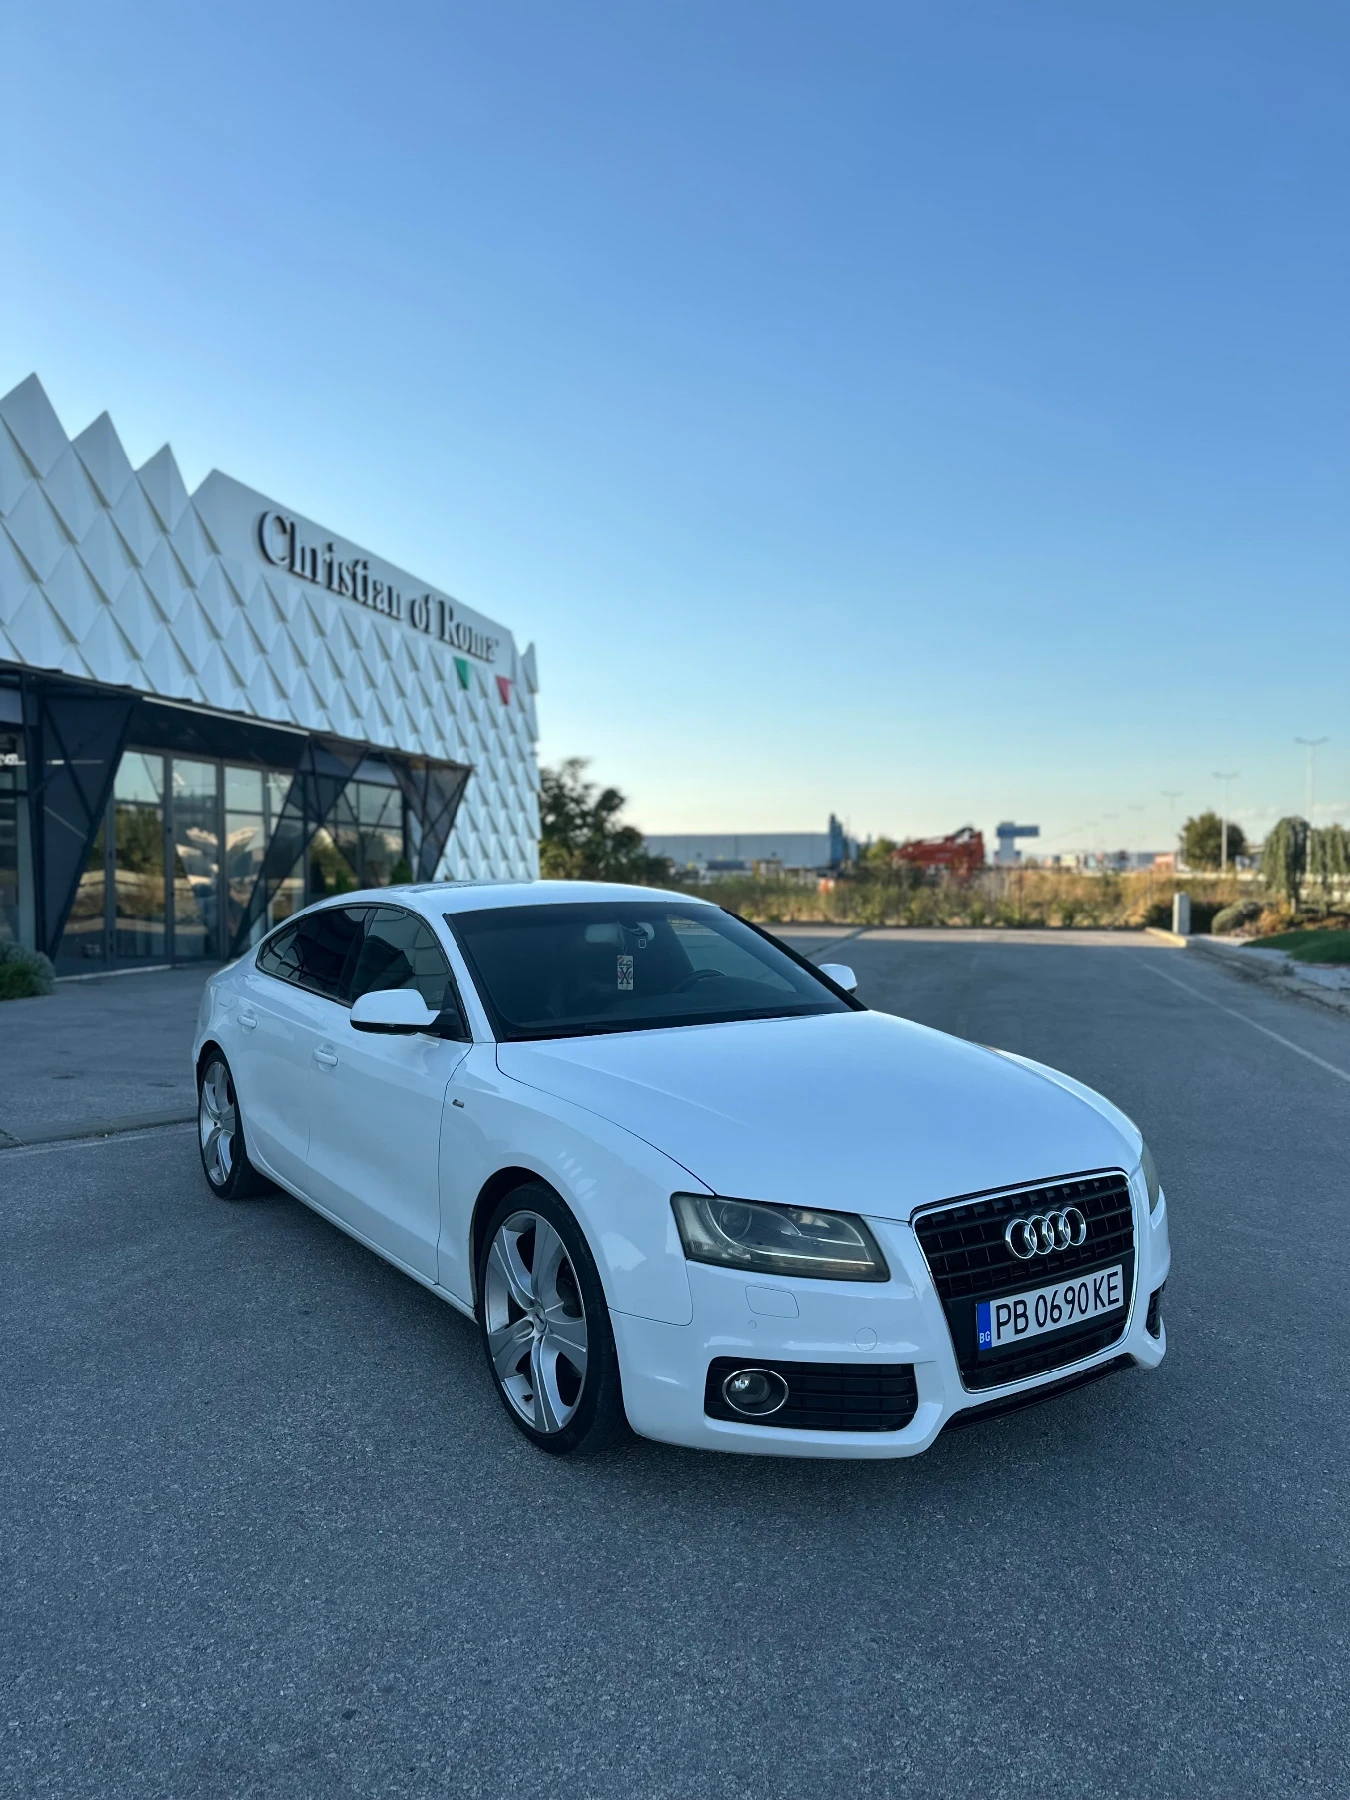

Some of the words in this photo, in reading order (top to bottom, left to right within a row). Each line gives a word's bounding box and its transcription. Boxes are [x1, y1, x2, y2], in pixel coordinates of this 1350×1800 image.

[257, 510, 402, 621] Christian
[409, 593, 435, 635] of
[979, 1331, 991, 1344] BG
[995, 1299, 1029, 1340] PB
[1035, 1282, 1089, 1328] 0690
[1093, 1270, 1120, 1311] KE
